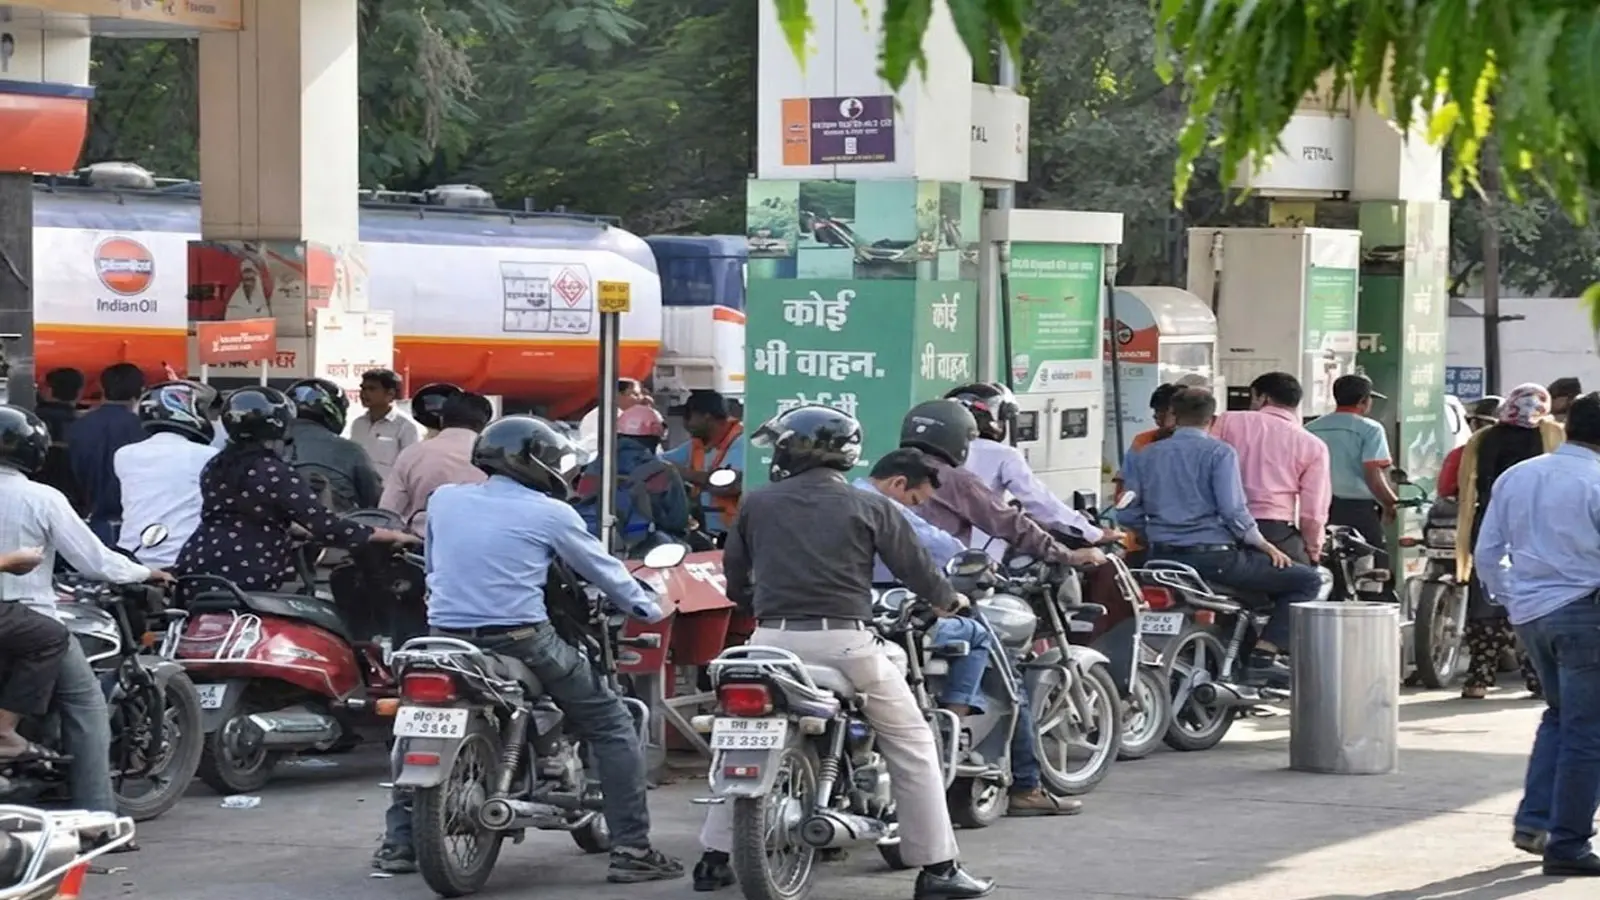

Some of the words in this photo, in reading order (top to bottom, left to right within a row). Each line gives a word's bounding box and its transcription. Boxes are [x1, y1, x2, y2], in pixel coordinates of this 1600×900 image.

[97, 298, 158, 313] IndianOil
[783, 289, 856, 332] कोई
[931, 292, 961, 333] कोई
[754, 339, 790, 376] भी
[795, 350, 885, 381] वाहन.
[920, 342, 936, 380] भी
